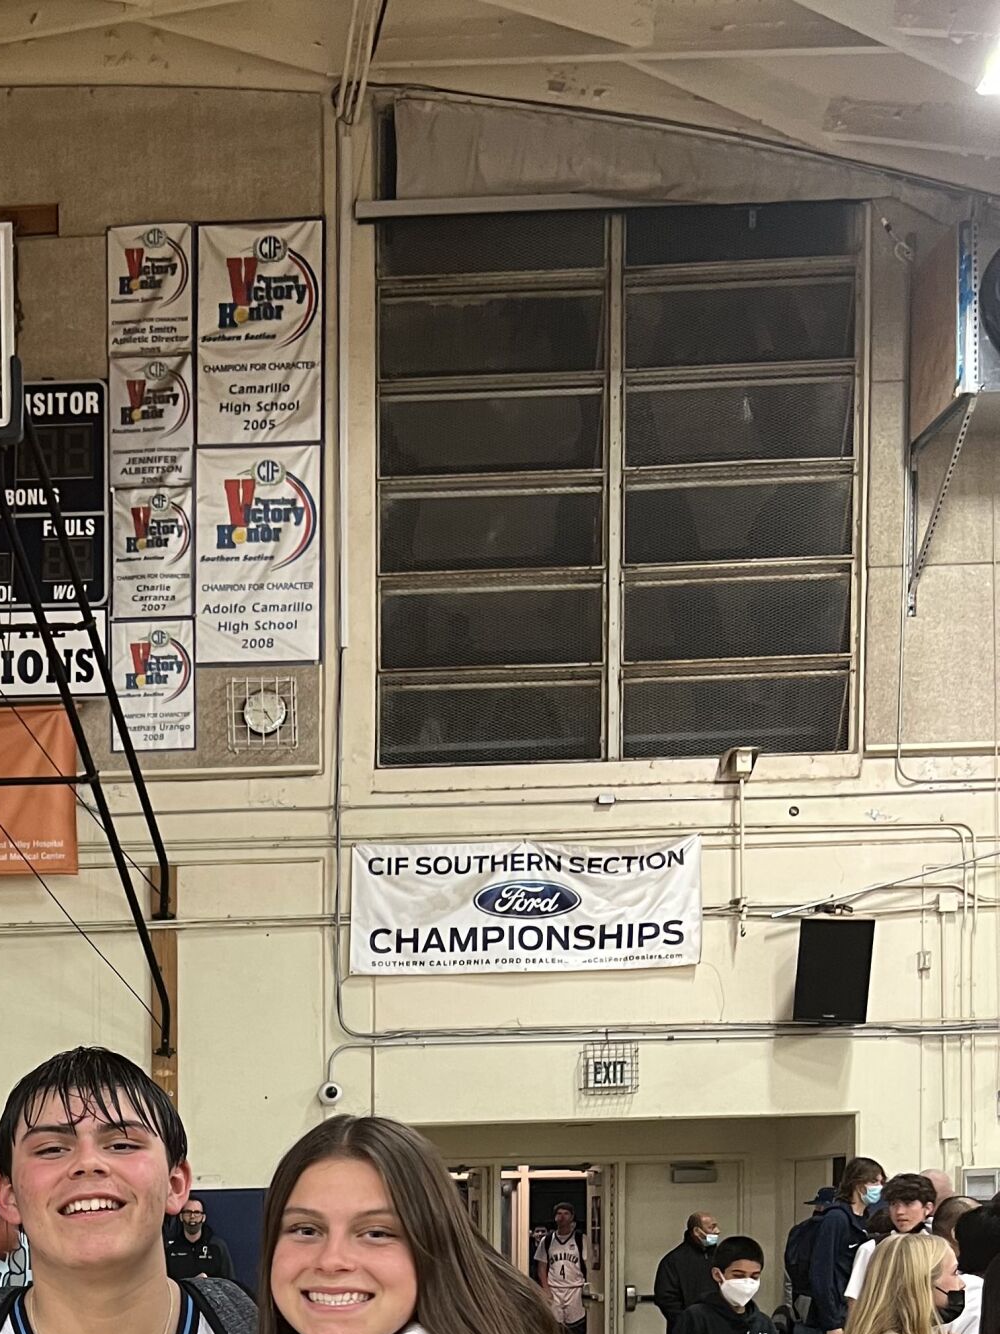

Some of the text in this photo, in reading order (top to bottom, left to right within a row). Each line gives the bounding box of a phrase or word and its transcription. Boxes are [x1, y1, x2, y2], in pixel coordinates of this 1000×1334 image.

[258, 235, 282, 259] CIF
[123, 325, 177, 335] Mike Smith
[112, 334, 190, 345] Athletic Director
[203, 360, 315, 374] CHAMPION FOR CHARACTER
[228, 382, 291, 395] Camarillo
[218, 400, 300, 416] High School
[243, 419, 276, 431] 2005
[126, 455, 177, 466] JENNIFER
[120, 465, 182, 475] ALBERTSON
[257, 460, 280, 483] CIF
[136, 584, 171, 592] Charlie
[201, 581, 314, 592] CHAMPION FOR CHARACTER
[132, 594, 176, 602] Carranza
[141, 604, 166, 612] 2007
[202, 601, 313, 614] Adolfo Camarillo
[217, 619, 298, 635] High School
[241, 637, 275, 649] 2008
[368, 847, 686, 876] CIF SOUTHERN SECTION
[494, 886, 560, 914] Ford
[369, 919, 685, 954] CHAMPIONSHIPS
[371, 959, 425, 967] SOUTHERN
[429, 958, 491, 967] CALIFORNIA
[593, 1061, 627, 1084] EXIT
[560, 1264, 566, 1280] 4
